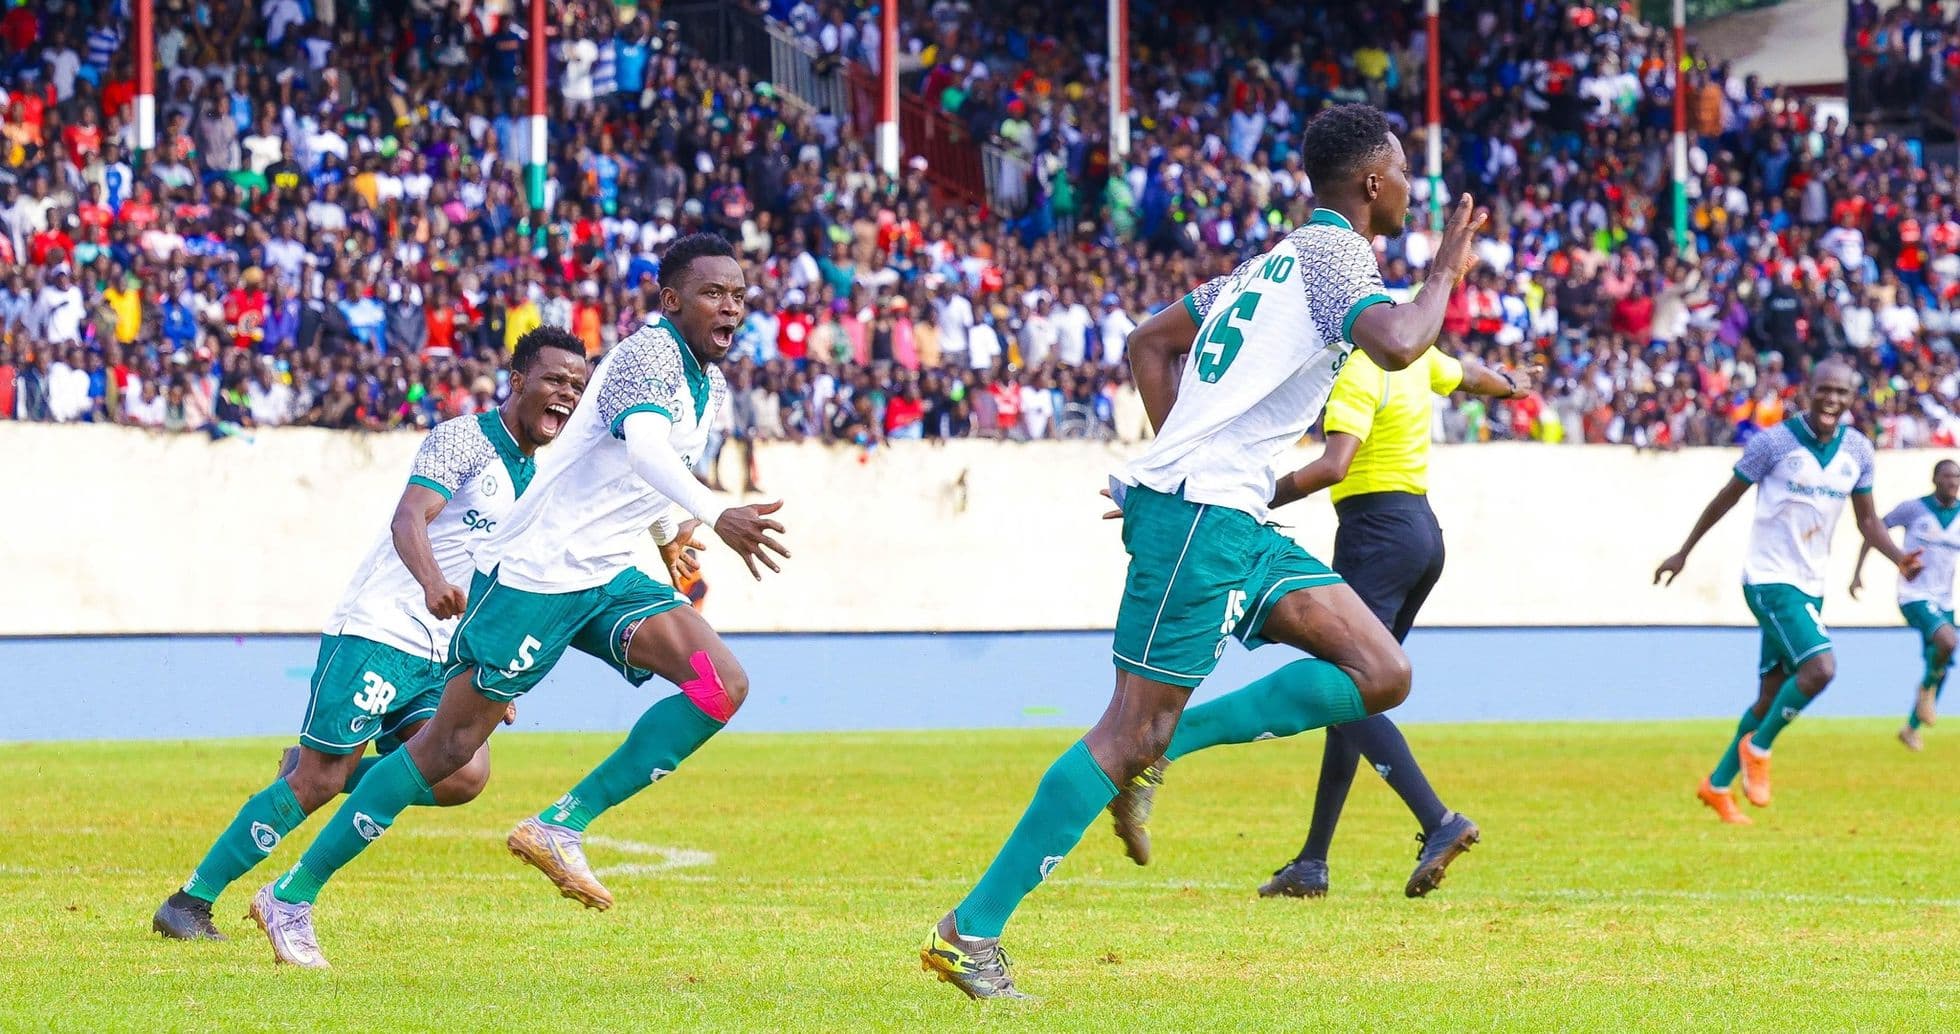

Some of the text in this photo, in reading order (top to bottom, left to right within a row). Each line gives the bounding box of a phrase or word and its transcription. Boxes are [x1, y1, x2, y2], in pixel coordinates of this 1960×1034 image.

[1194, 291, 1262, 384] 15
[509, 634, 542, 671] 5
[353, 671, 397, 715] 38
